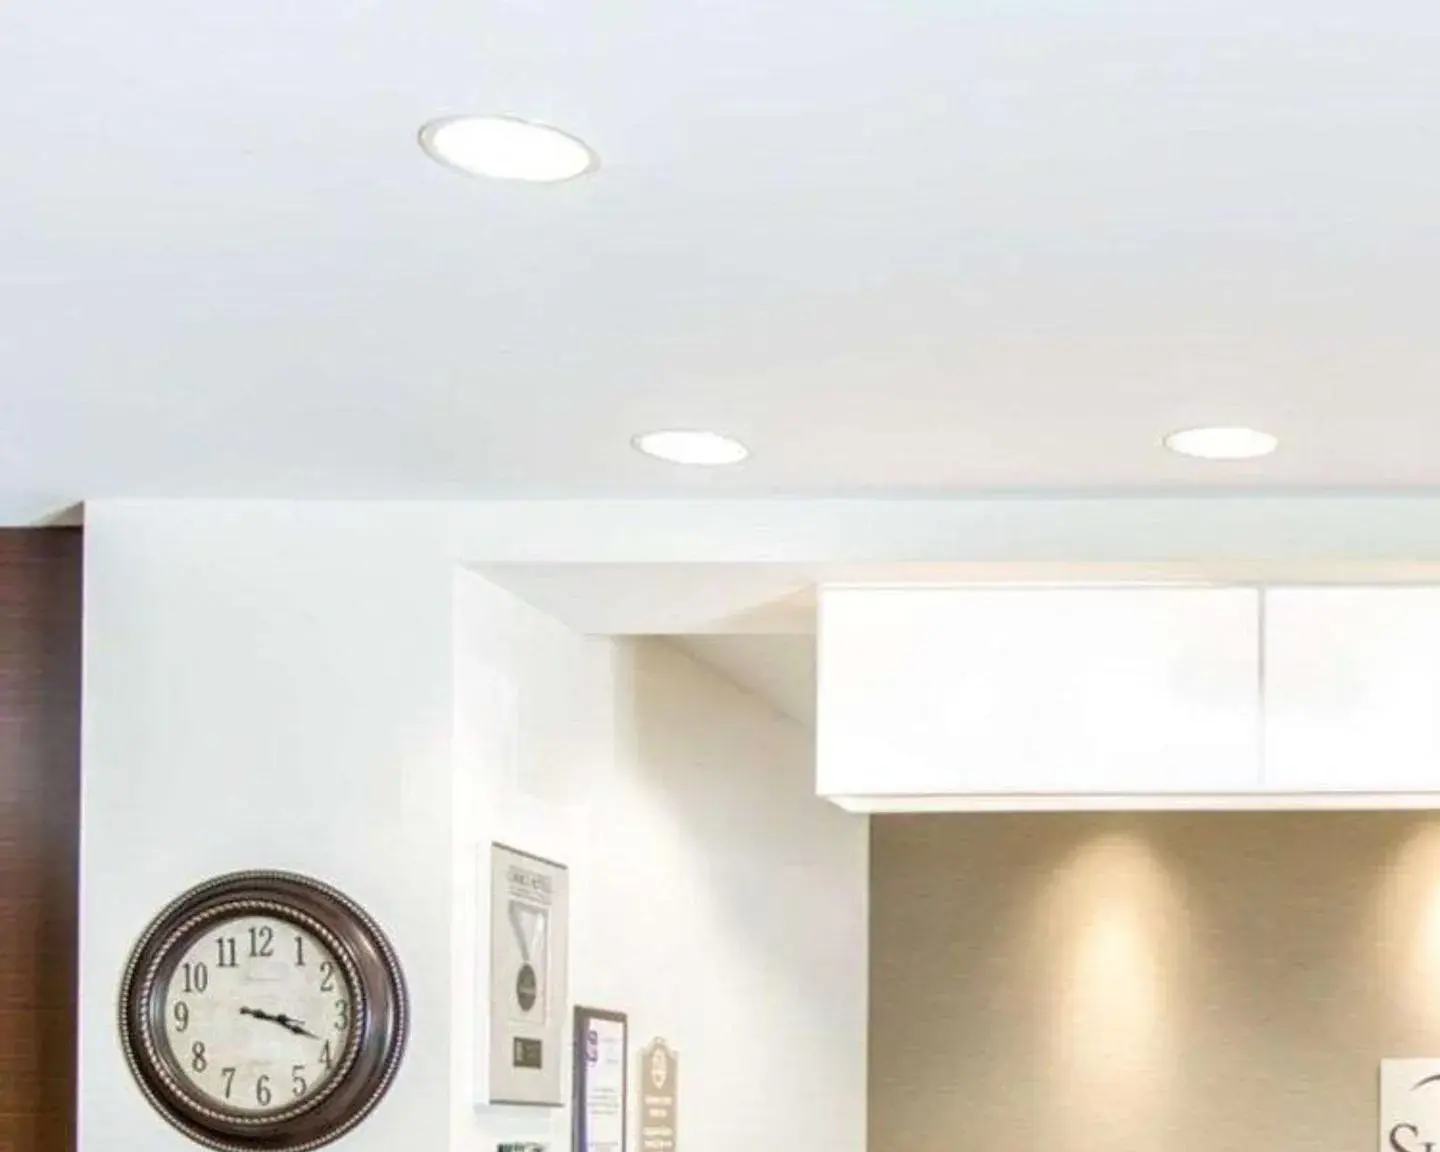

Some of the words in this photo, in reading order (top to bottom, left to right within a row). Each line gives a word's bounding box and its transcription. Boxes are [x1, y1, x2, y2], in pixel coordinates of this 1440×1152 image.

[216, 937, 239, 968] 11
[248, 927, 273, 957] 12
[294, 937, 305, 965] 1
[183, 963, 208, 993] 10
[320, 961, 333, 991] 2
[174, 1002, 188, 1032] 9
[335, 1000, 348, 1030] 3
[192, 1042, 206, 1072] 8
[319, 1040, 333, 1070] 4
[222, 1068, 235, 1098] 7
[256, 1076, 271, 1106] 6
[292, 1066, 306, 1095] 5
